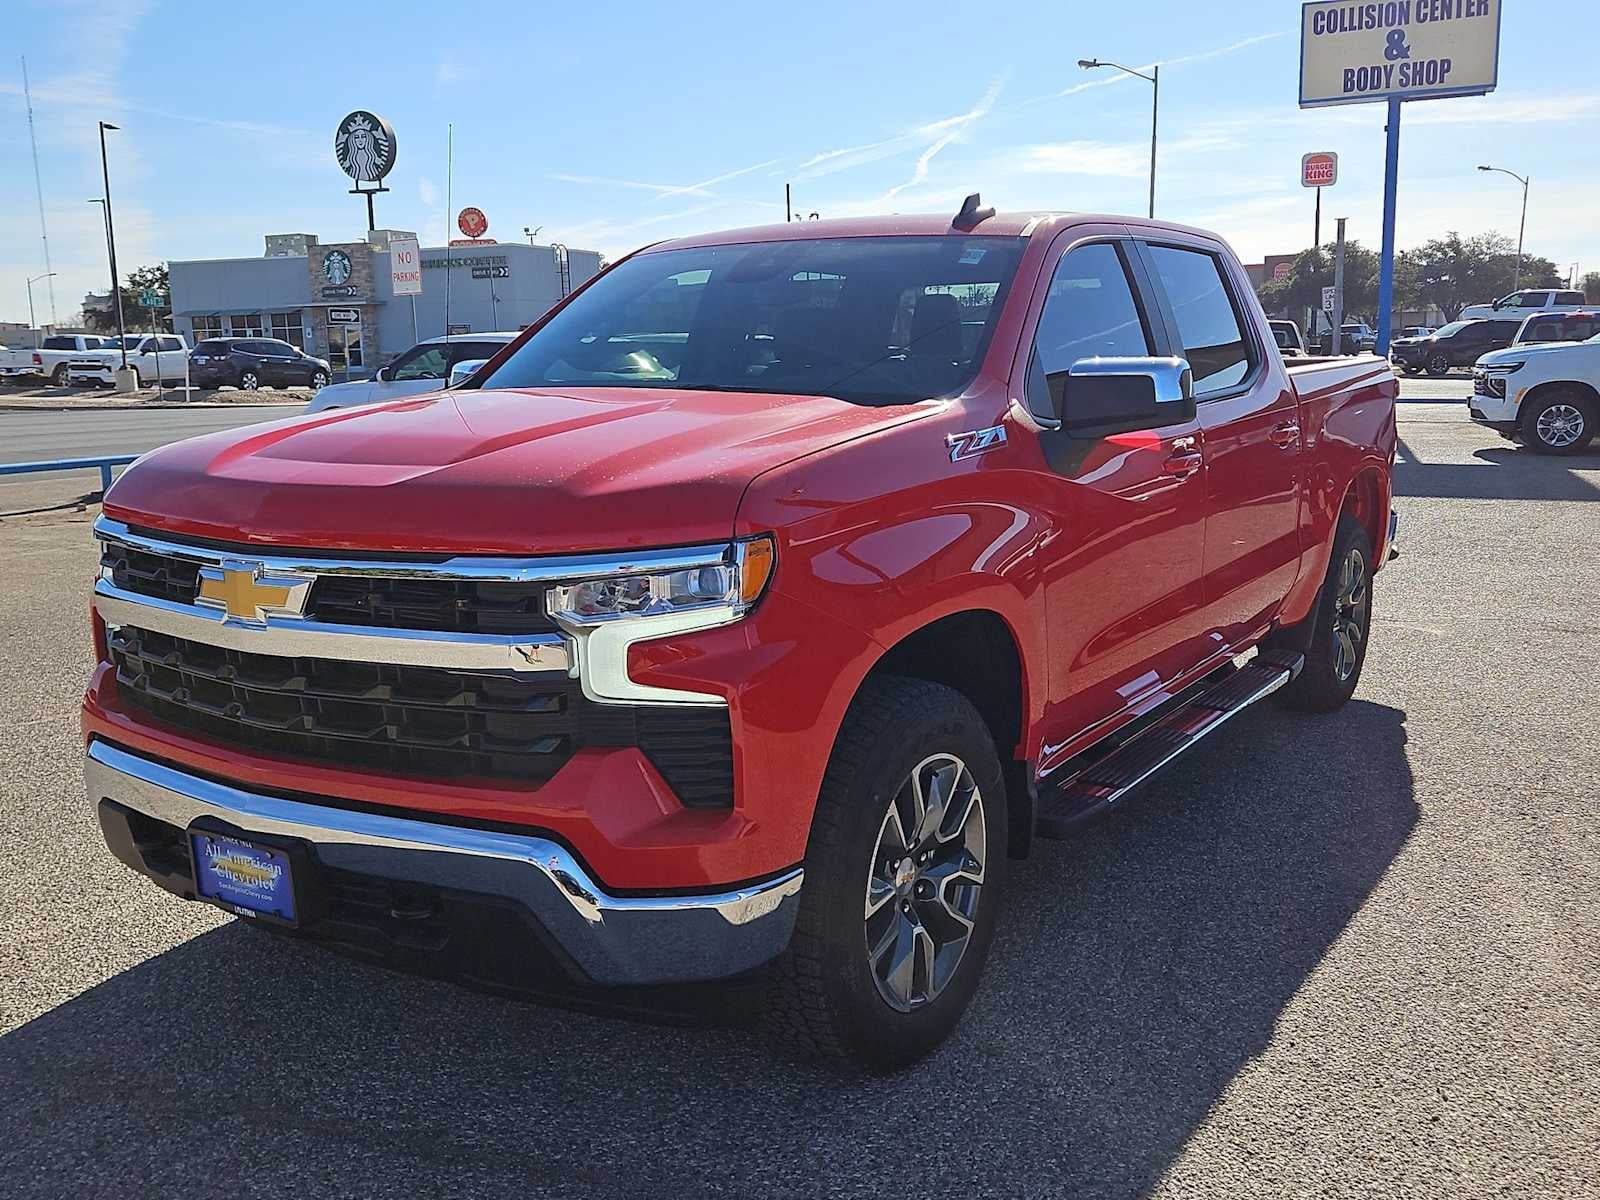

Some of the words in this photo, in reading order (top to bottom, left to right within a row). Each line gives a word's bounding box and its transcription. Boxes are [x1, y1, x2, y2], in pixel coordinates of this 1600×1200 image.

[1313, 0, 1410, 35] COLLISION
[1416, 0, 1488, 23] CENTER
[1384, 29, 1411, 61] &
[1343, 64, 1395, 93] BODY
[1400, 58, 1452, 88] SHOP
[1305, 163, 1333, 171] BURGER
[1305, 170, 1333, 179] KING
[398, 251, 412, 264] NO
[393, 271, 419, 281] PARKING
[944, 425, 1008, 462] Z71
[225, 849, 282, 875] American
[216, 864, 275, 891] Chevrolet
